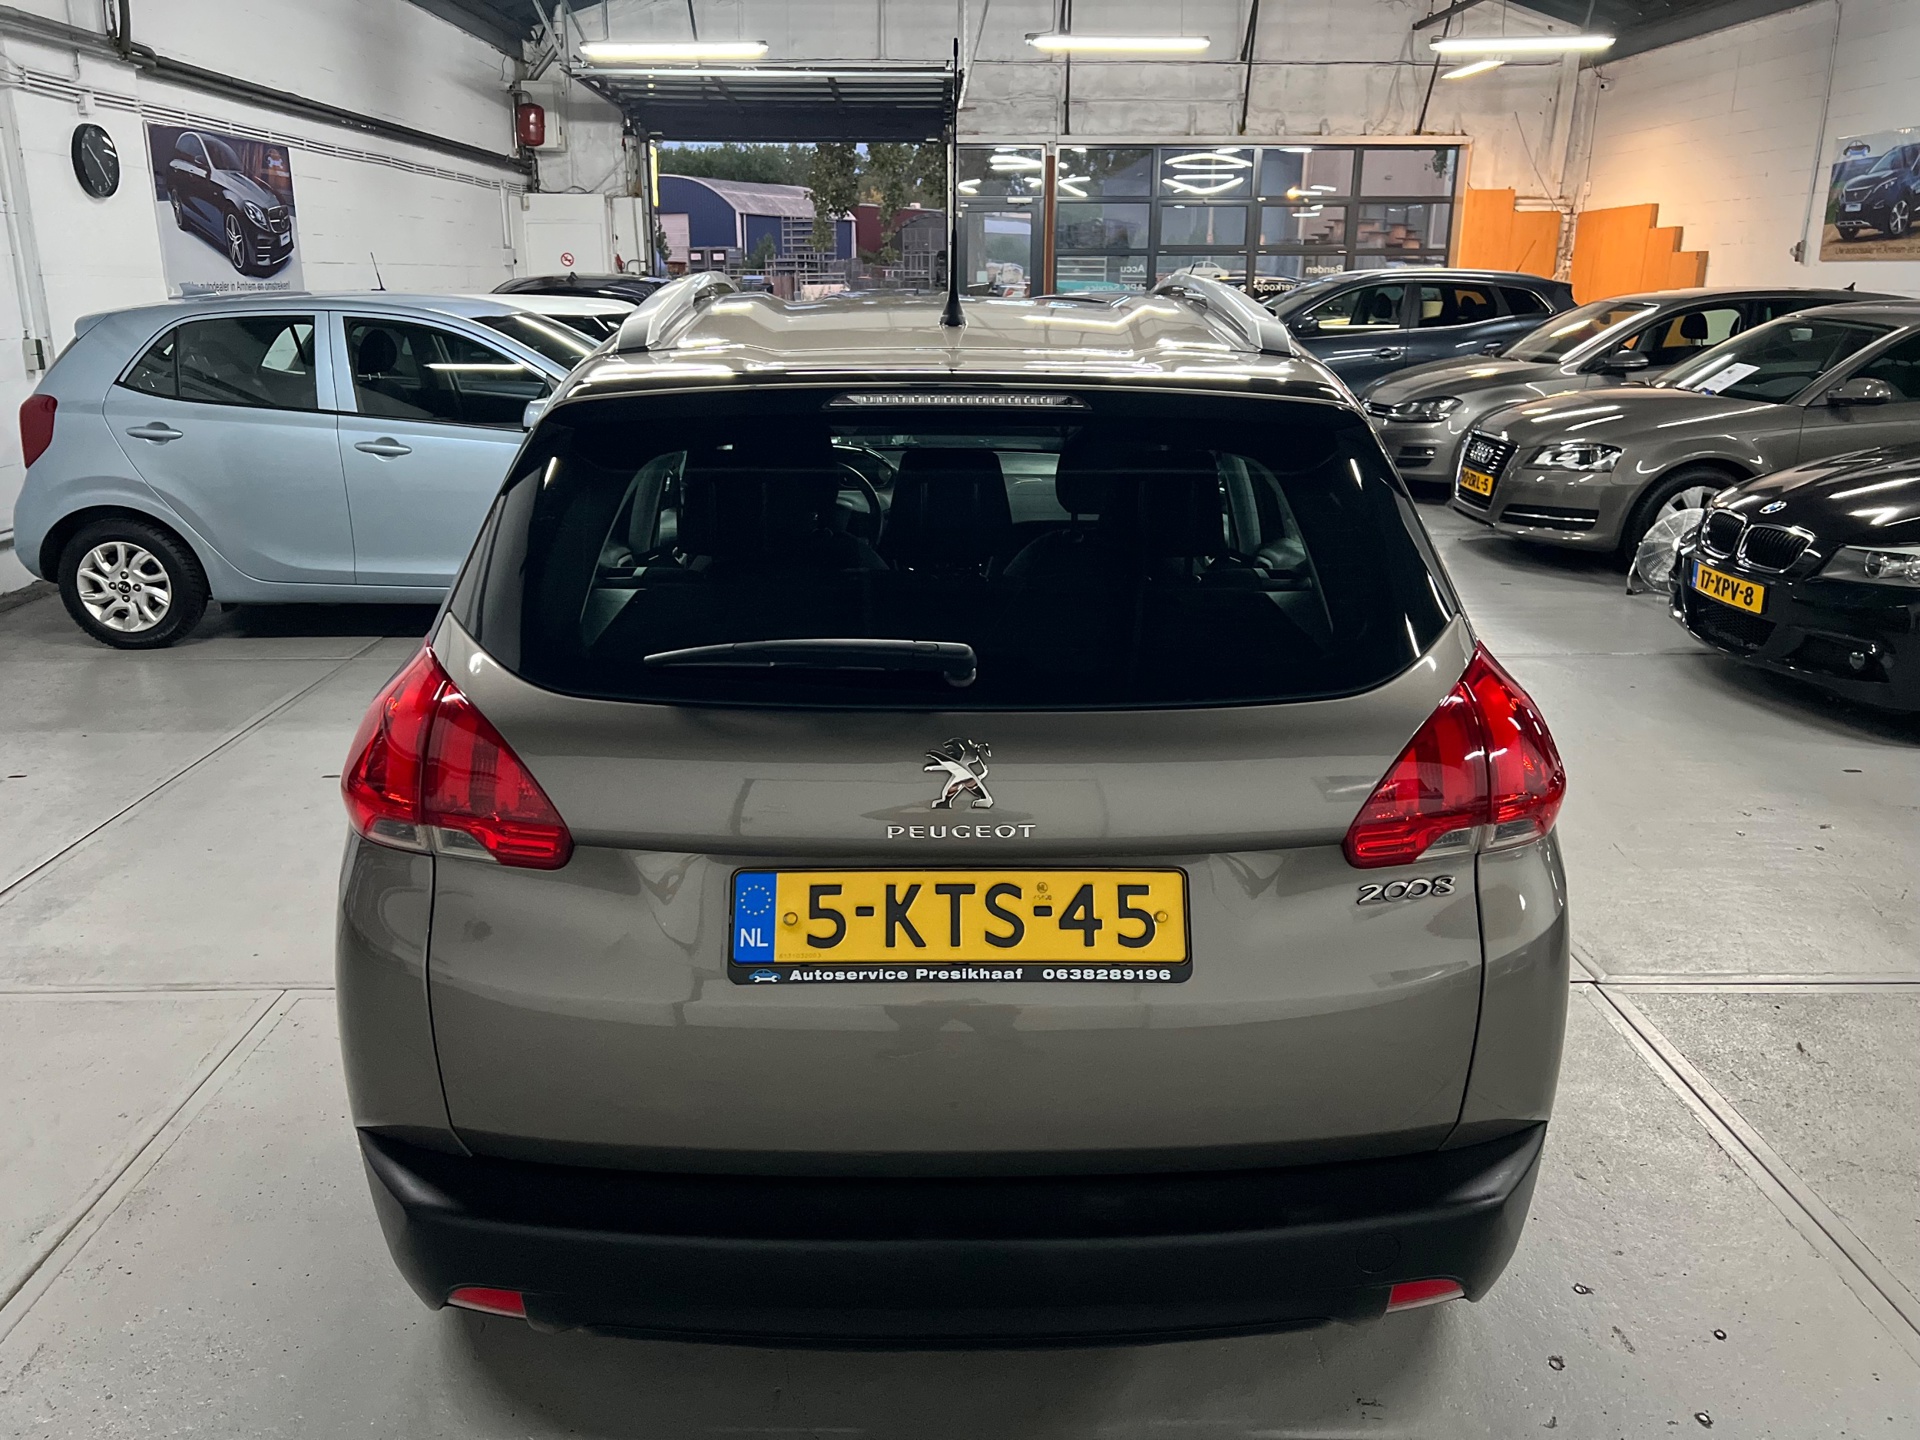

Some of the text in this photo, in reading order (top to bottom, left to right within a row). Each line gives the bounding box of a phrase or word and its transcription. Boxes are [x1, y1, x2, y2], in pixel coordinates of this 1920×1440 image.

[1700, 569, 1754, 607] 17-XPV-8
[886, 823, 1037, 840] PEUGEOT
[1357, 875, 1456, 905] 2008
[806, 882, 1156, 949] 5-KTS-45
[740, 928, 769, 948] NL
[789, 967, 1171, 981] Autoservice Presikhaaf 0638289196
